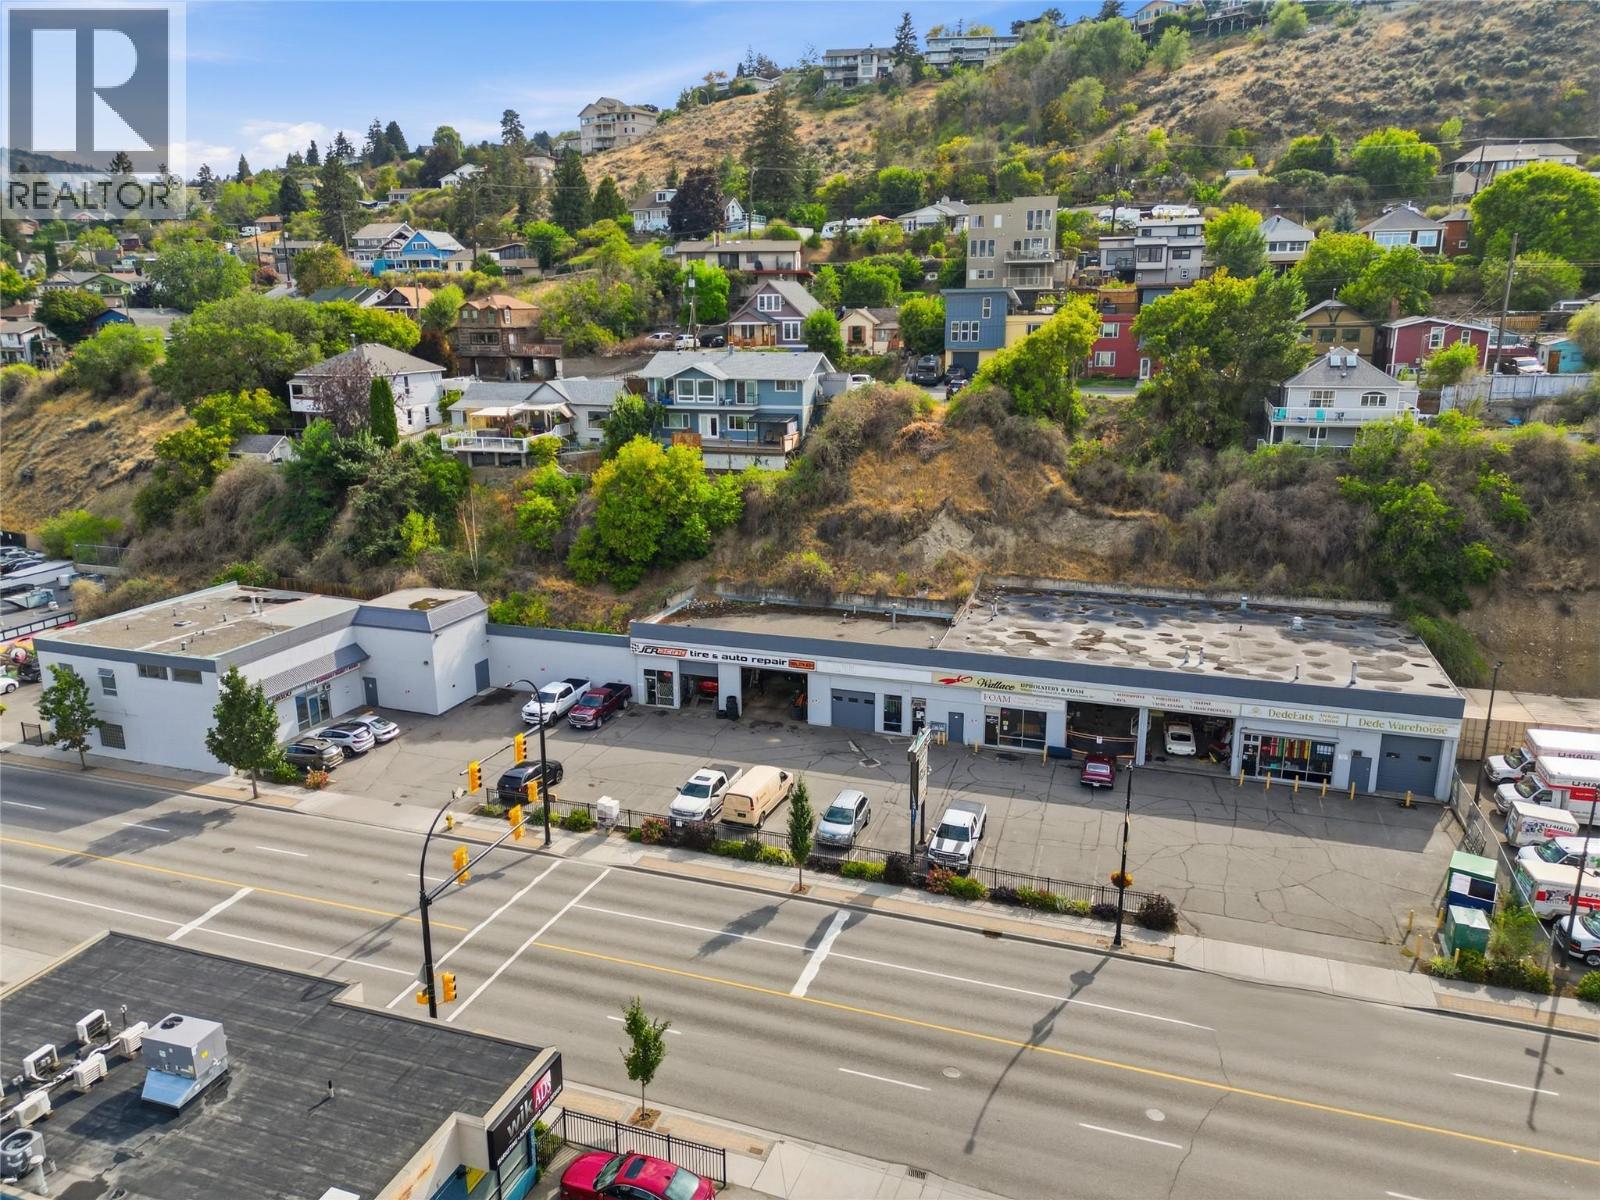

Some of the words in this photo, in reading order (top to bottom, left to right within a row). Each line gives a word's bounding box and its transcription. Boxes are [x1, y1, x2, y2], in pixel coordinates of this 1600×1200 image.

[690, 651, 710, 659] tire
[751, 657, 787, 666] repair
[976, 677, 1016, 691] Wallace
[983, 693, 1011, 704] FOAM
[1268, 708, 1314, 721] DedeEats
[1358, 717, 1385, 729] Dede
[1388, 719, 1448, 735] Warehouse
[1558, 752, 1596, 760] U-HAUL
[1545, 822, 1574, 833] U-HAUL
